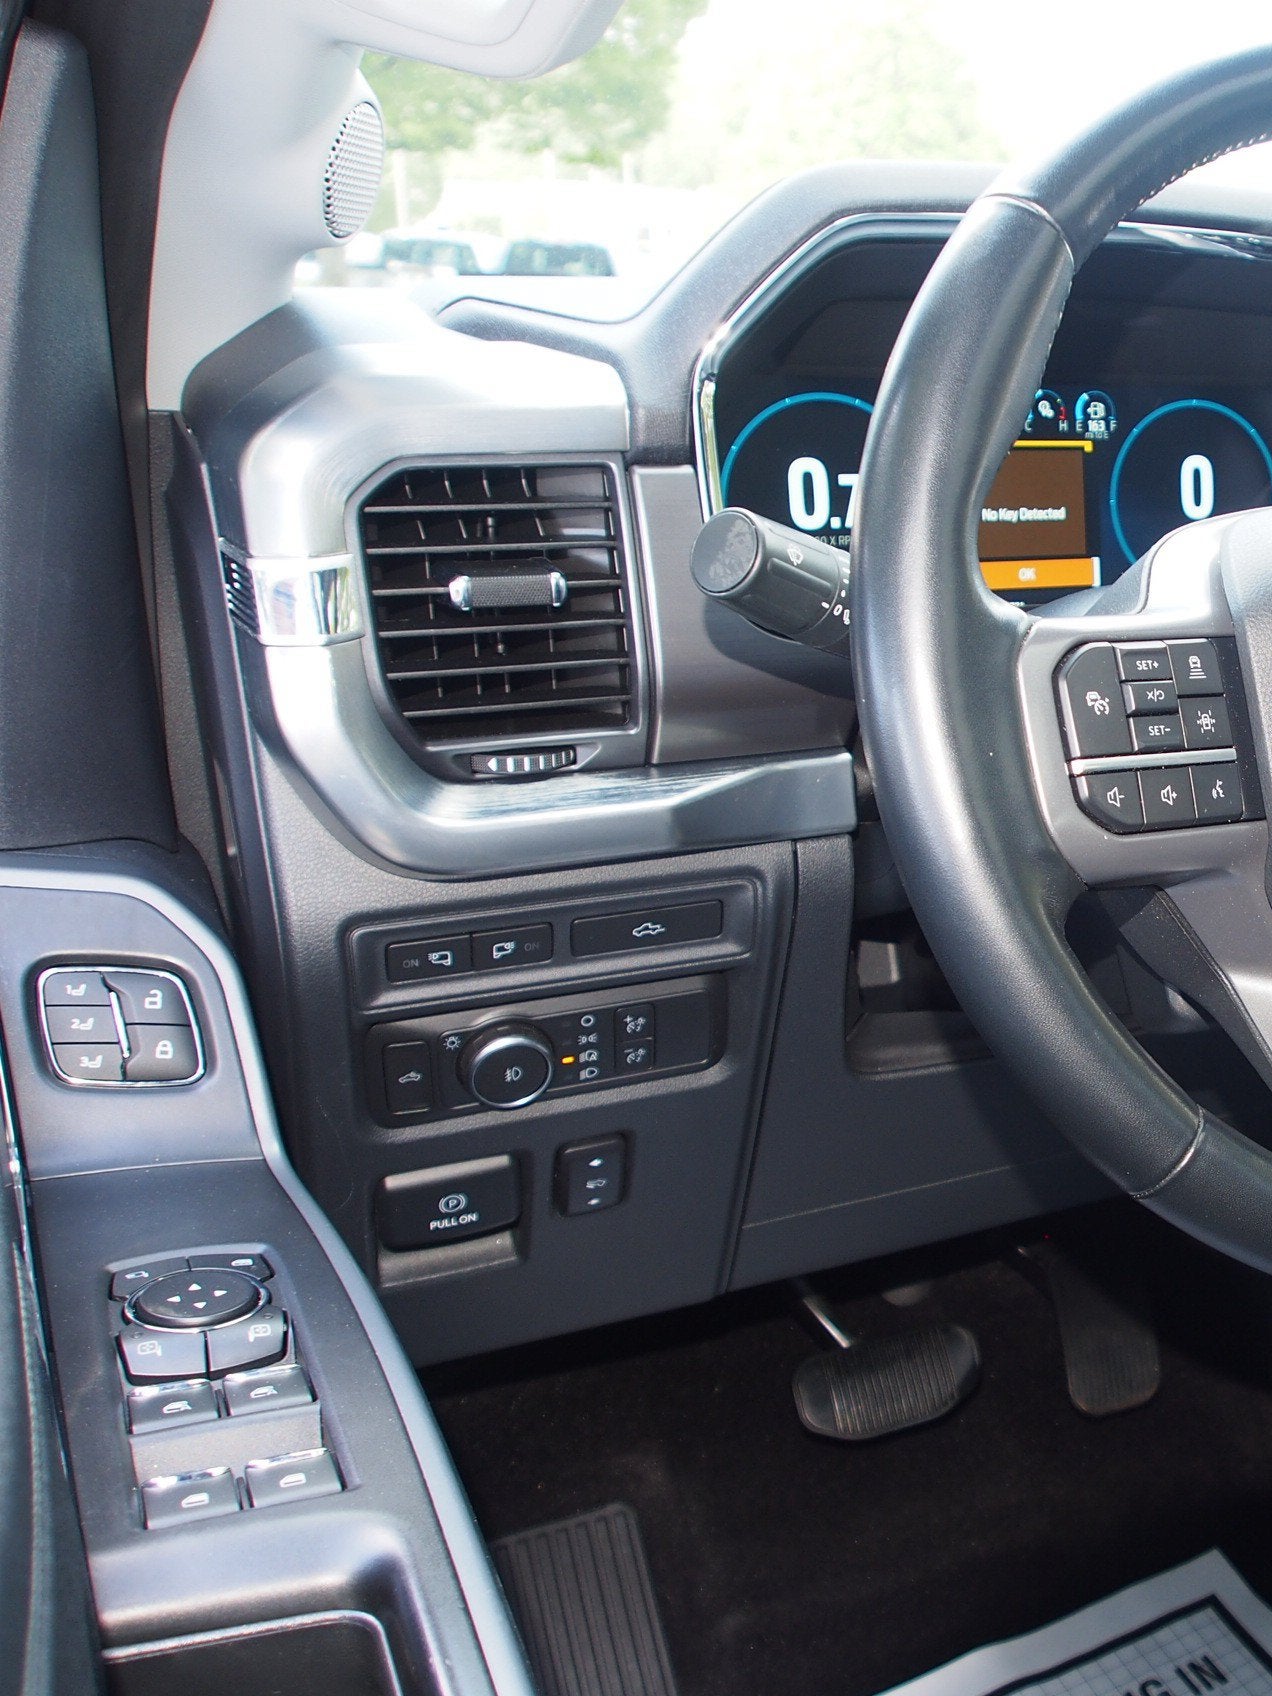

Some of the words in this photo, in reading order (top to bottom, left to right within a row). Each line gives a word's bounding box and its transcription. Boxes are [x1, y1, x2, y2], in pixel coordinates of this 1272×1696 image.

[1088, 420, 1105, 432] 163
[1180, 454, 1214, 521] 0
[982, 508, 999, 521] No
[999, 508, 1018, 523] Key
[1019, 506, 1066, 521] Detected
[403, 959, 419, 968] ON
[71, 1018, 80, 1029] 2
[80, 1056, 90, 1067] 3
[430, 1217, 458, 1230] PULL
[459, 1213, 477, 1224] ON
[1174, 1655, 1229, 1696] IN
